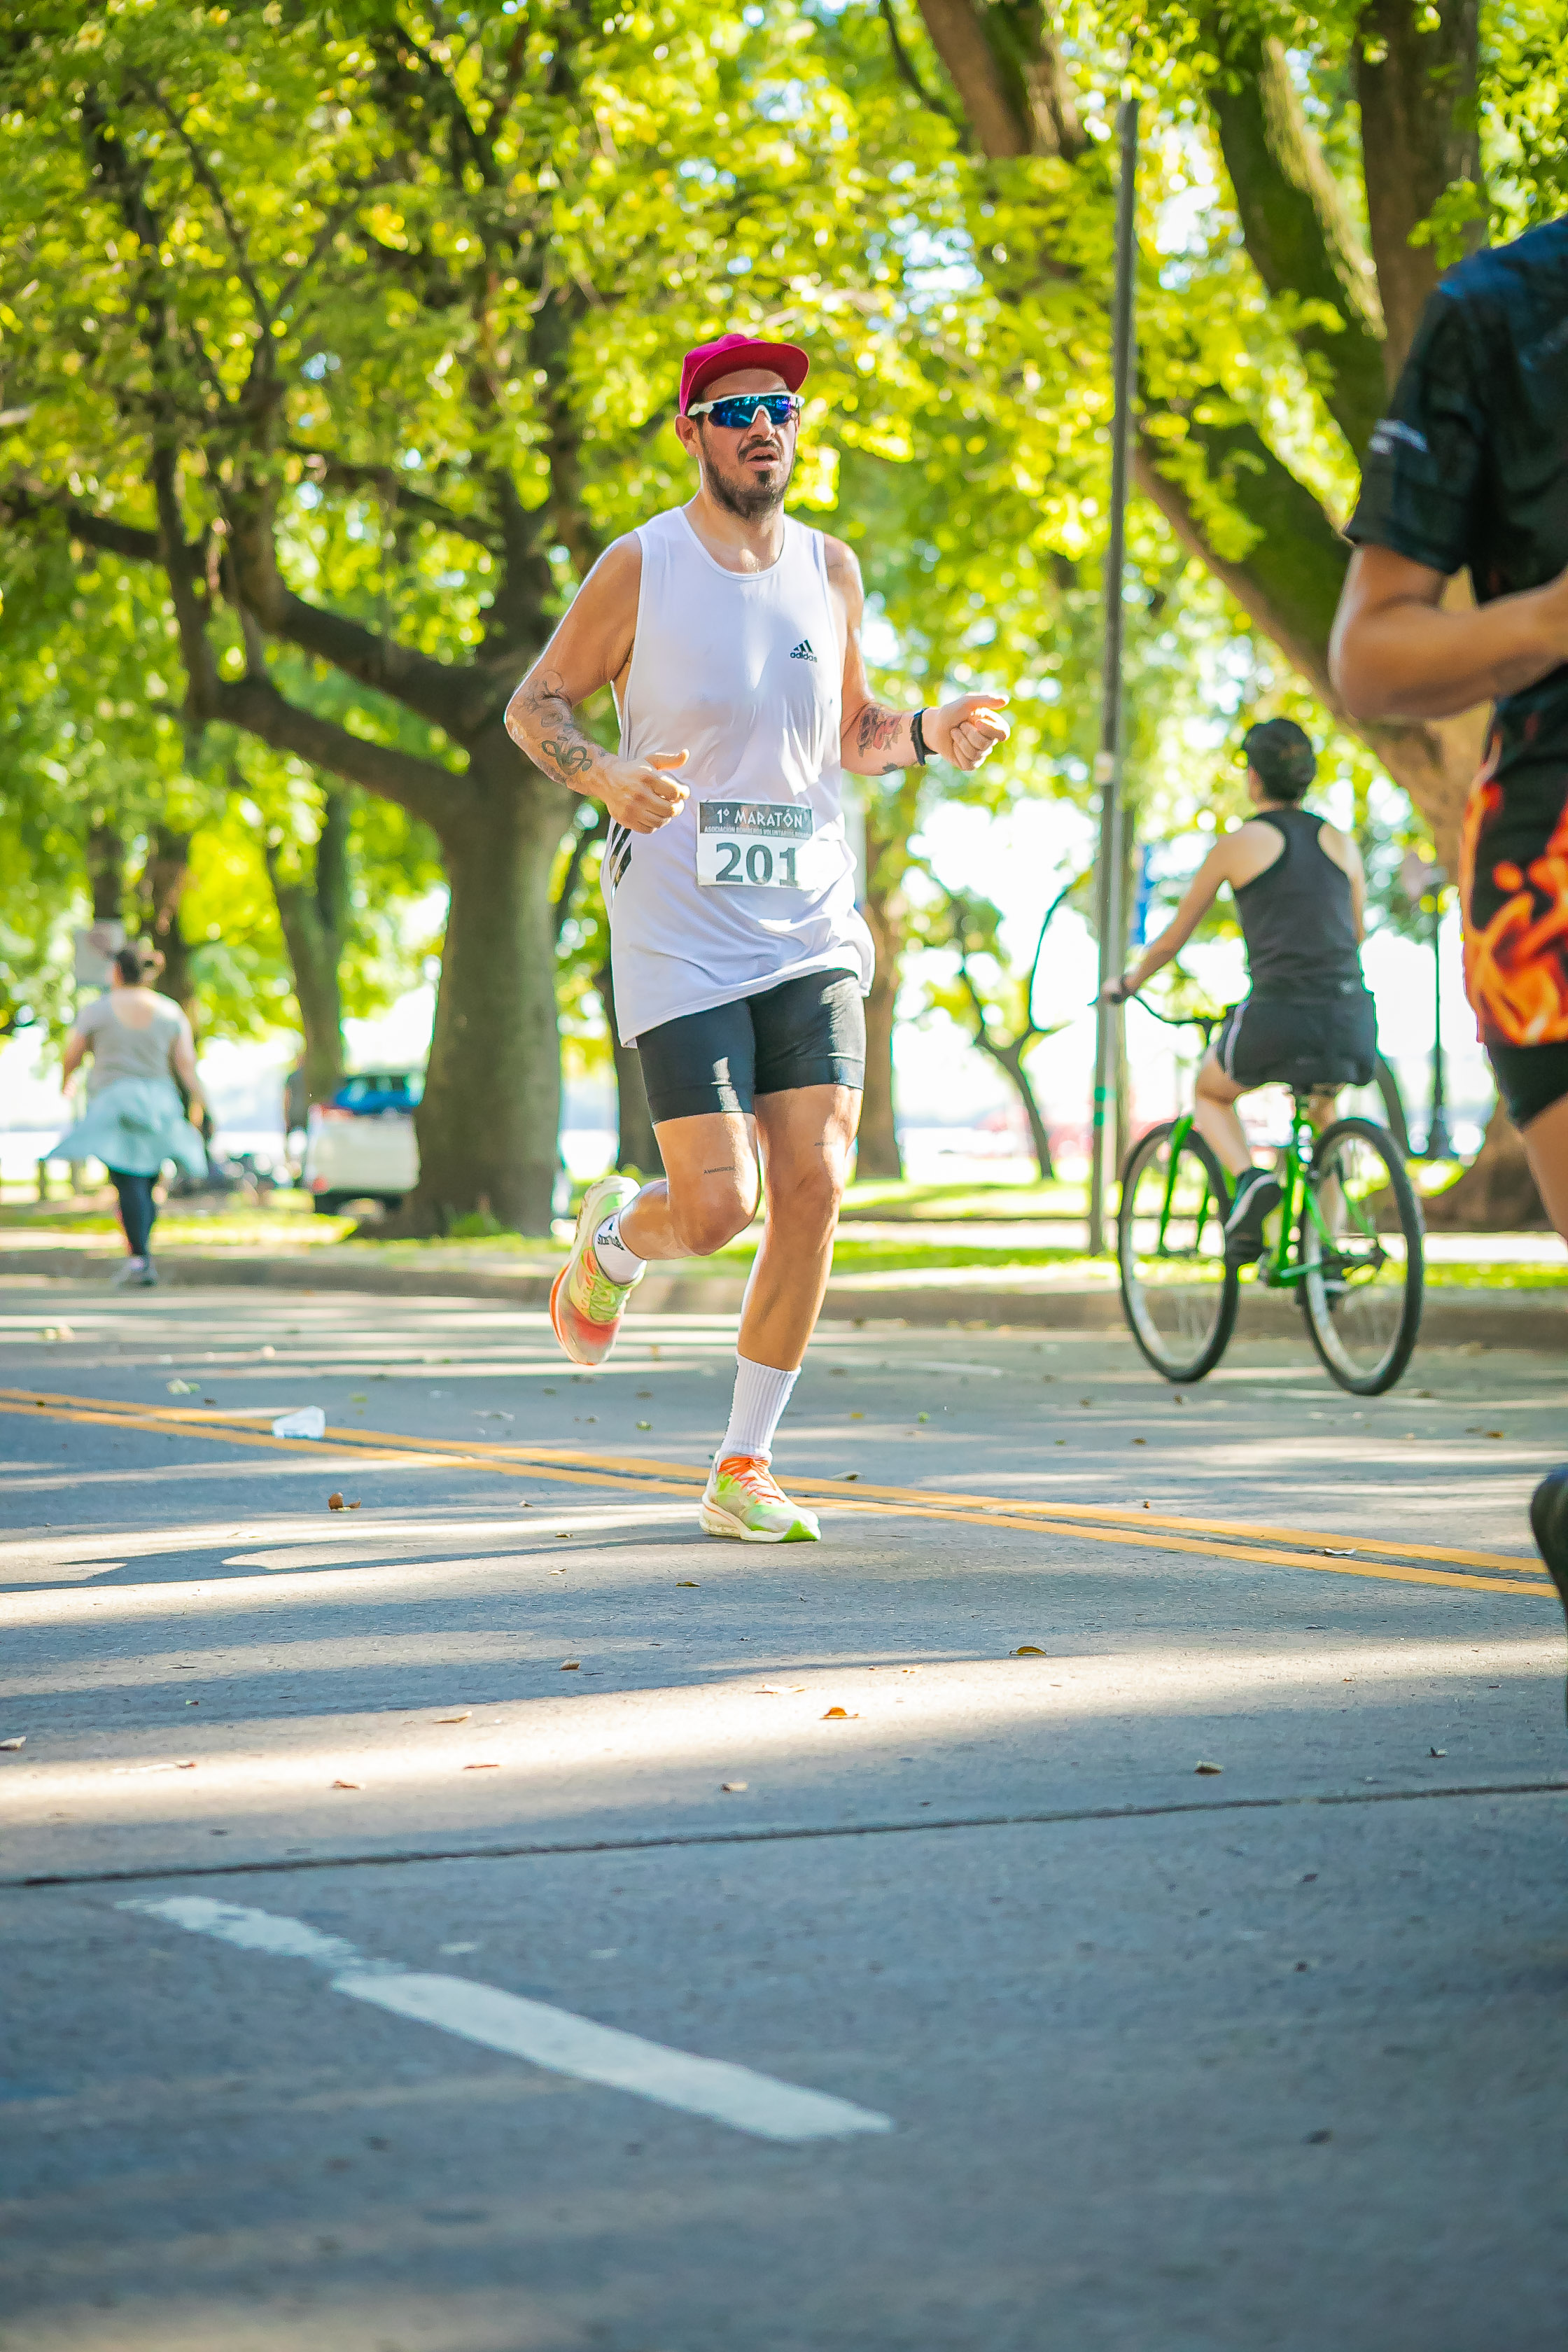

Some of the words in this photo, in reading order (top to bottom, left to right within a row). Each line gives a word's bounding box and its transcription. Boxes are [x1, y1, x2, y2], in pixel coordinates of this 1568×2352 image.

[790, 652, 818, 663] adidas
[734, 808, 803, 828] MARATÓN
[715, 842, 799, 886] 201
